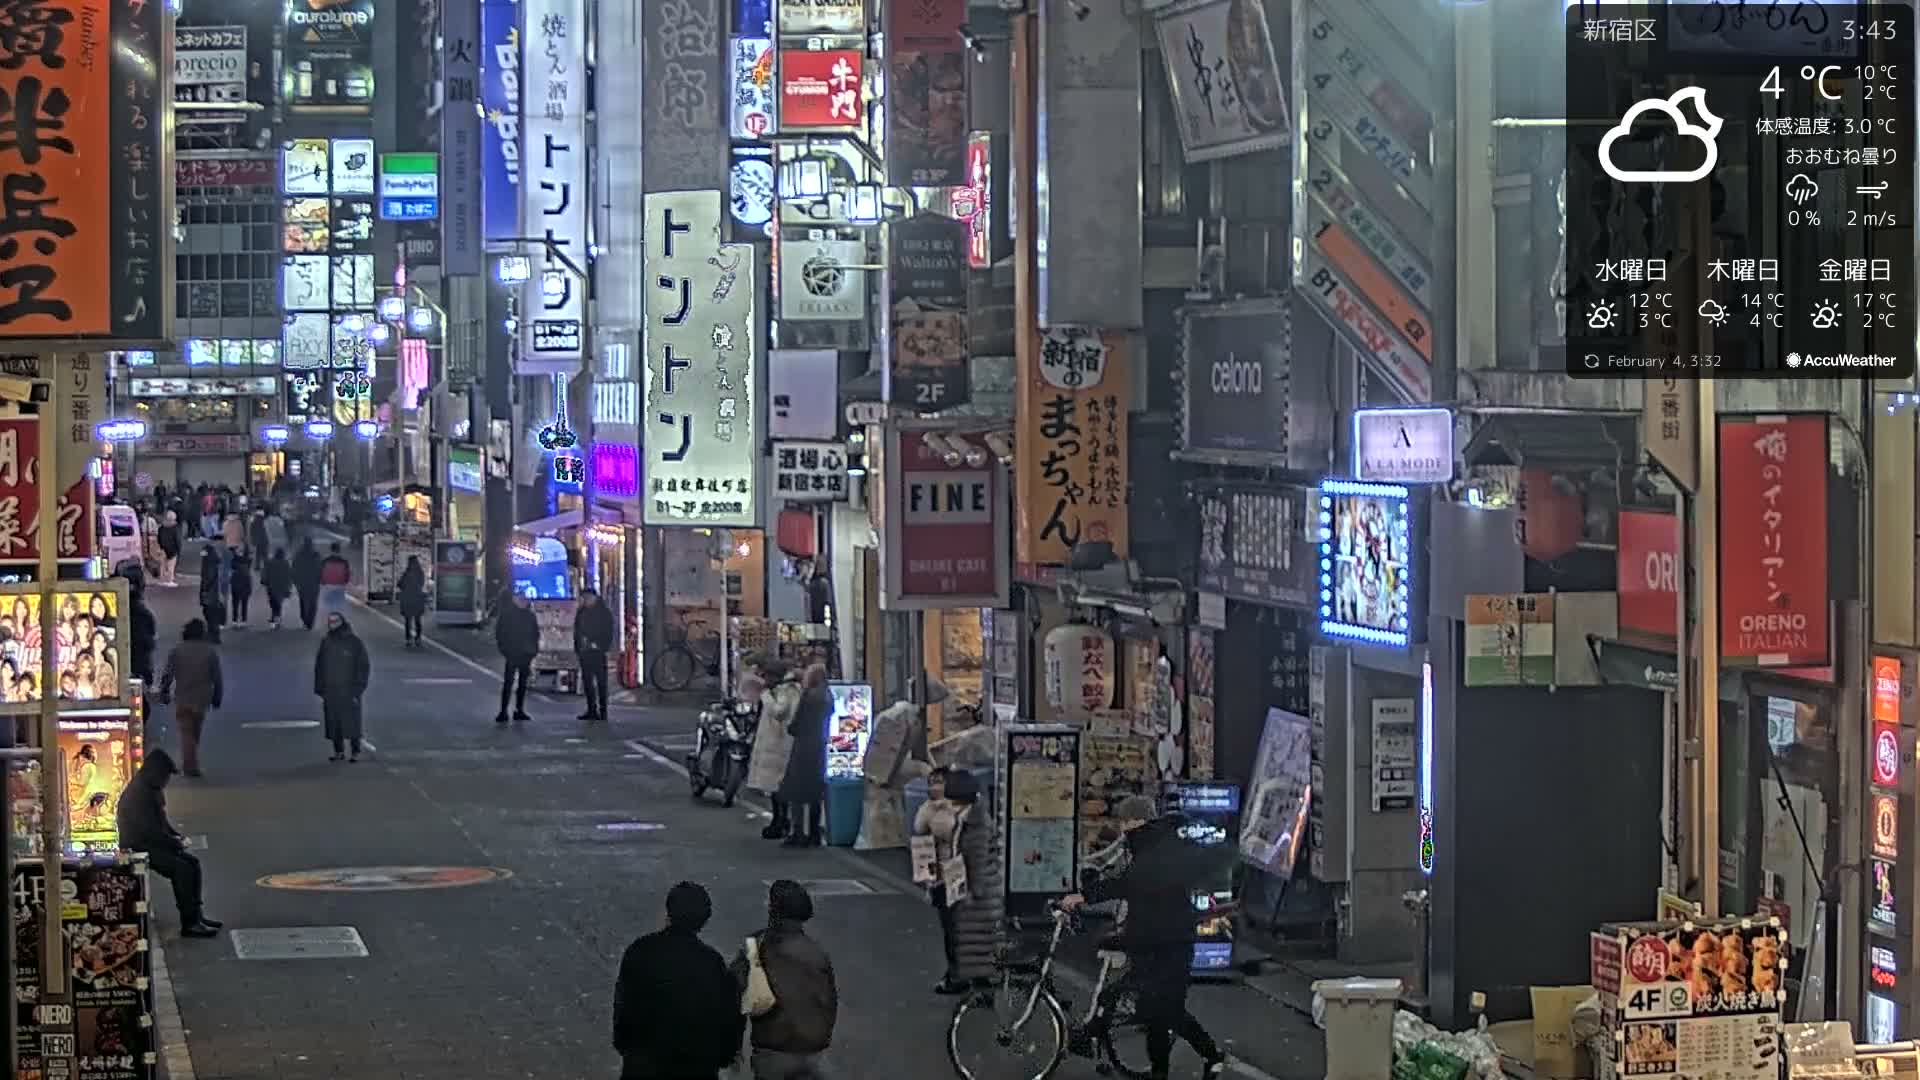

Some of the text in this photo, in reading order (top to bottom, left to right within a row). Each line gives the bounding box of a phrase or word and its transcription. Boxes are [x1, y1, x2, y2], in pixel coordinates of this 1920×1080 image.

[659, 209, 691, 461] トントン
[1212, 351, 1263, 394] celona
[72, 352, 91, 443] 通り一番街
[916, 383, 945, 404] 2F
[778, 449, 843, 470] 酒場心
[1040, 394, 1084, 547] まっちゃん
[778, 474, 843, 492] 新宿本店
[910, 483, 986, 512] FINE
[1753, 429, 1788, 601] 俺のイタリアン
[1740, 614, 1806, 632] ORENO
[1739, 634, 1807, 648] ITALIAN
[1629, 988, 1661, 1012] 4F
